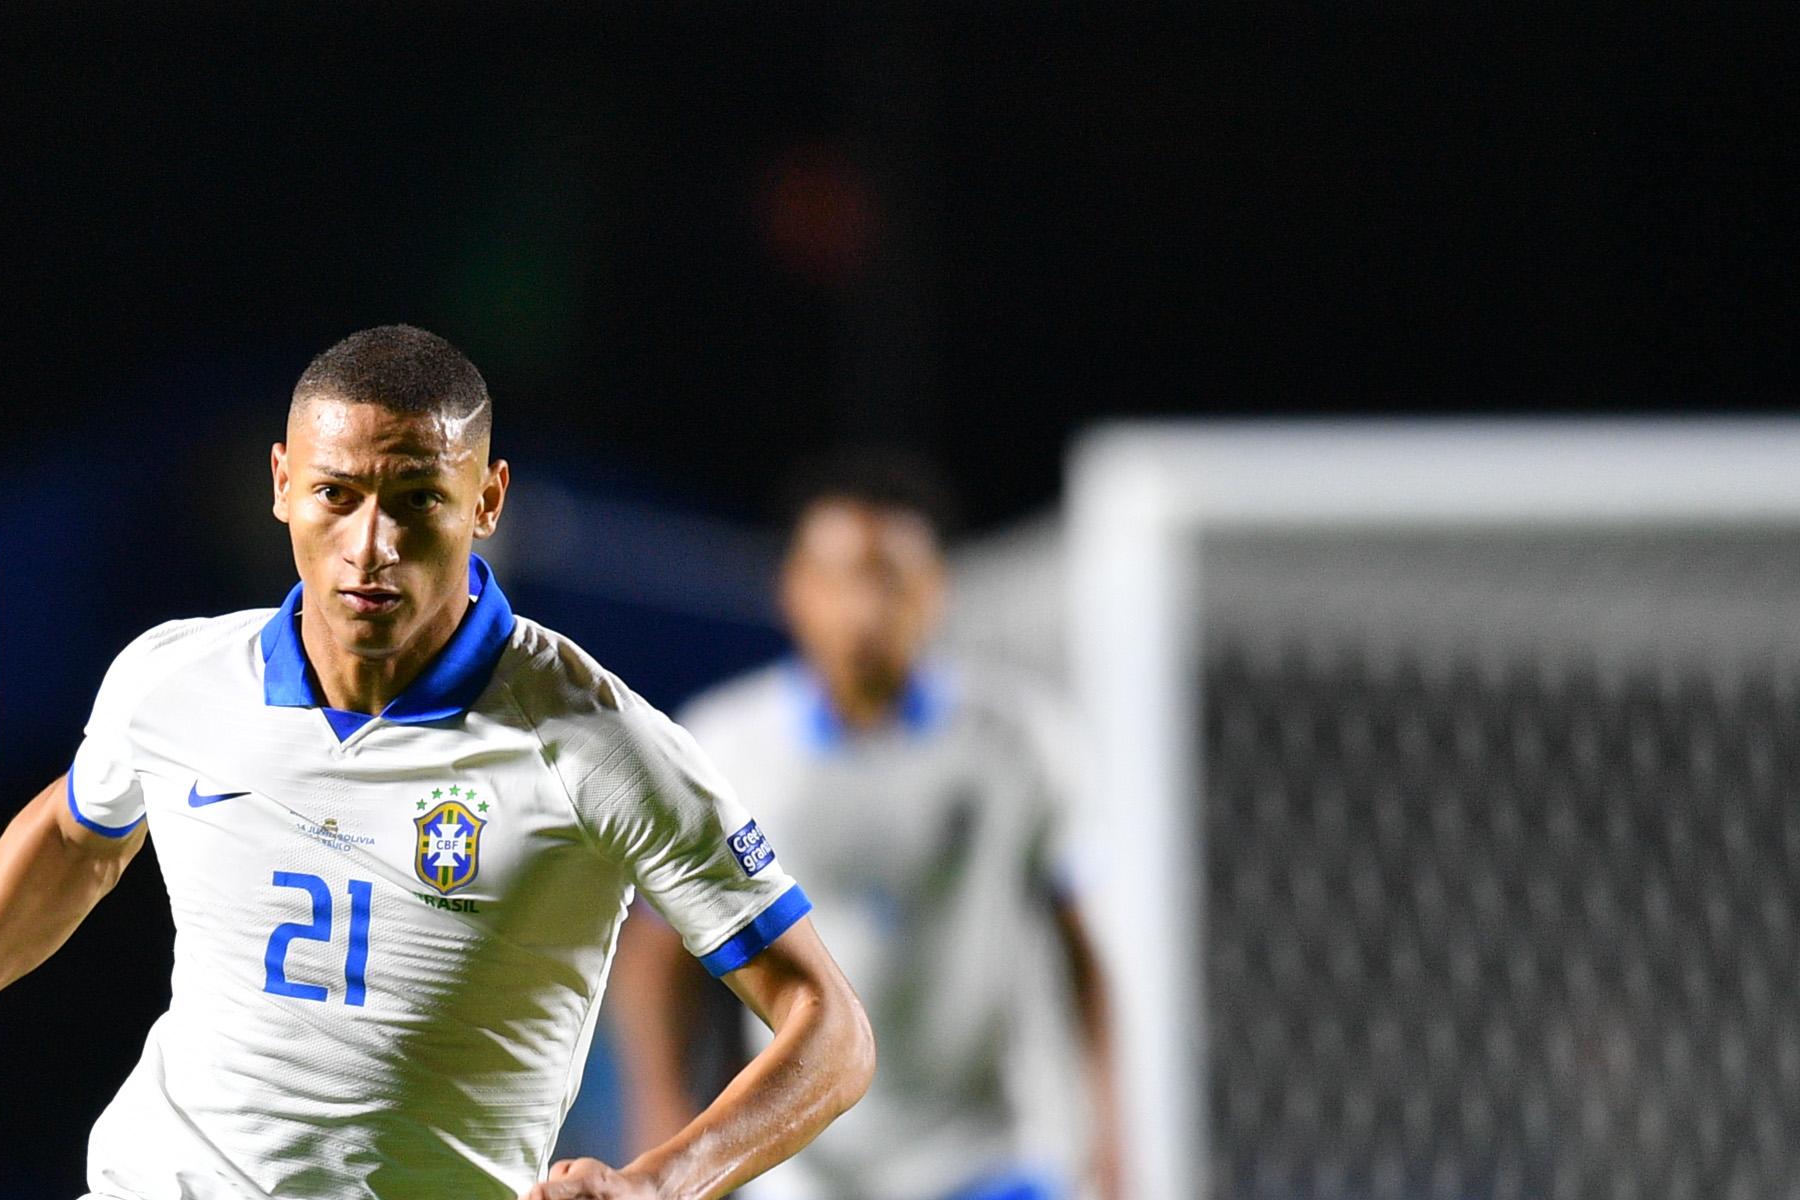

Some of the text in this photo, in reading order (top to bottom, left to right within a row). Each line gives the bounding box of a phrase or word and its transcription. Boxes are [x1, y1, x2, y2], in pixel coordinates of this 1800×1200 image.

[436, 839, 459, 850] CBF
[412, 891, 480, 914] RASIL
[263, 870, 373, 1008] 21
